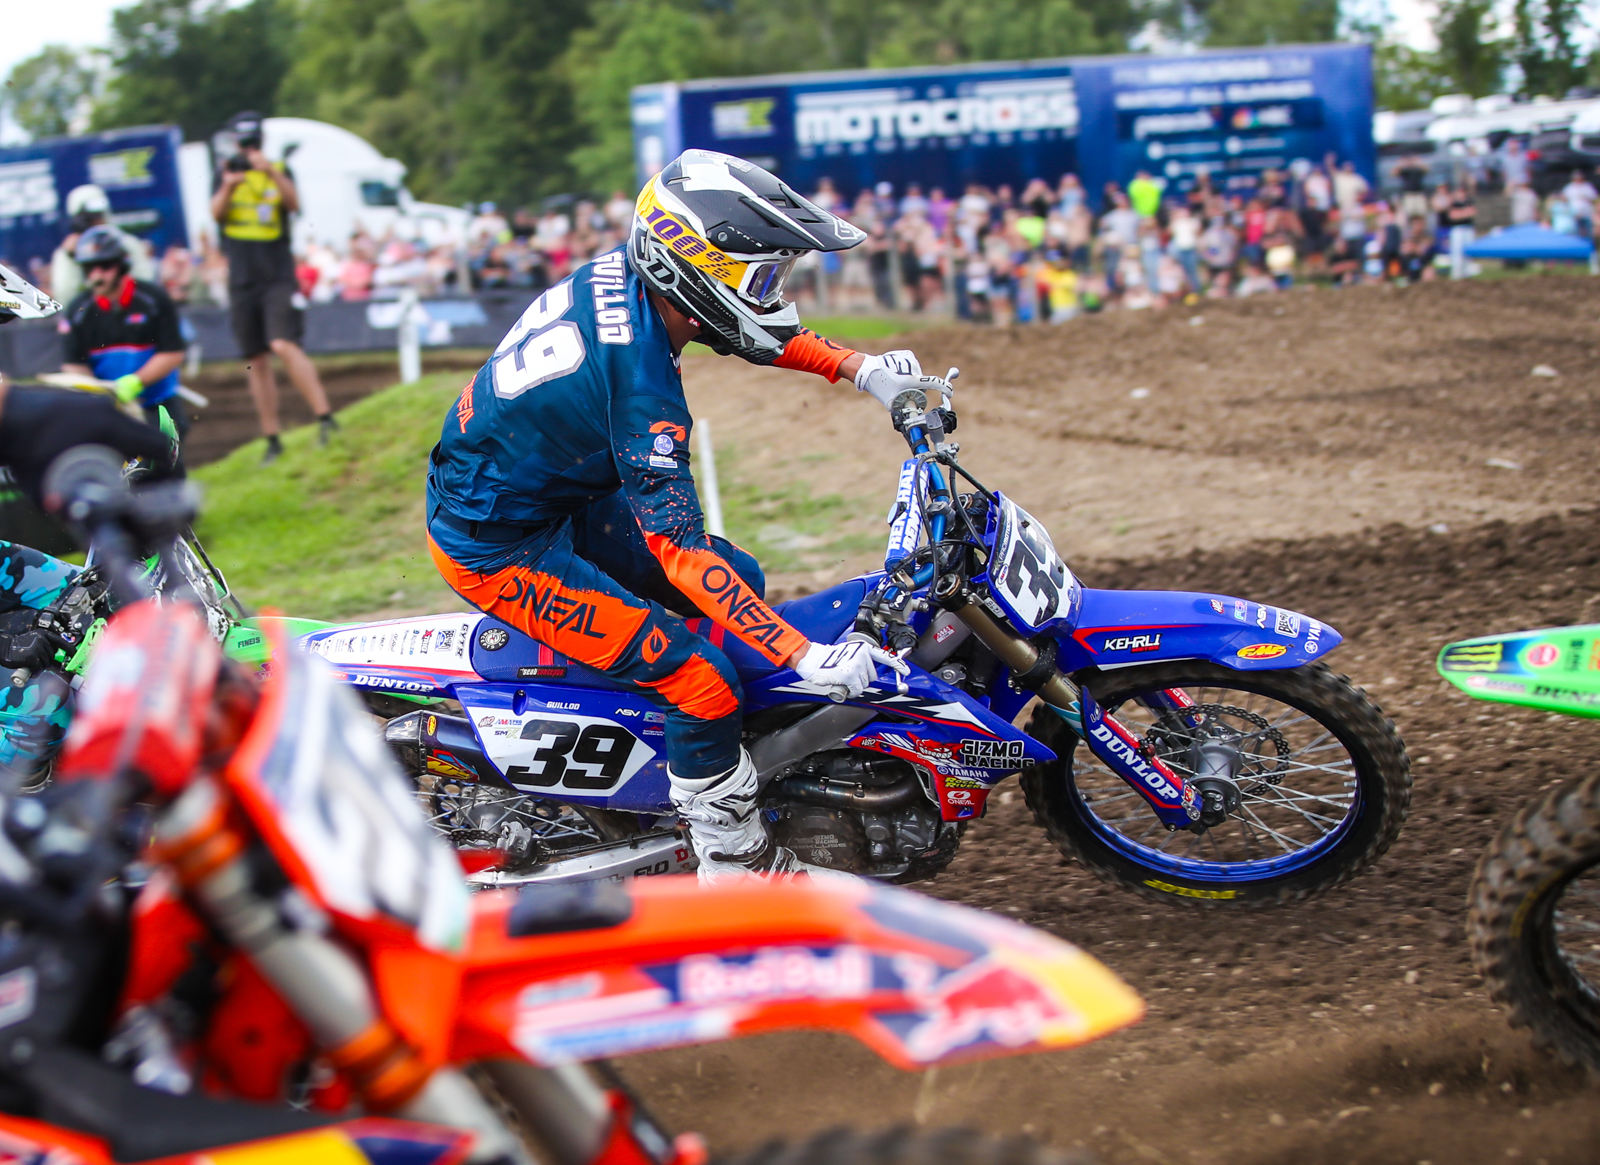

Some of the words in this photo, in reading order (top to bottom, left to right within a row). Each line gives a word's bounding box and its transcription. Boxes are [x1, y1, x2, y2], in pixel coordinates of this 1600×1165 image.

[795, 93, 1079, 145] MOTOCROSS
[889, 463, 917, 550] RENHAL
[1238, 645, 1287, 658] FMF
[353, 674, 434, 693] DUNLOP
[547, 701, 580, 710] GUILLOD
[615, 708, 641, 717] ASV
[505, 719, 638, 789] 39
[960, 739, 1024, 758] GIZMO
[964, 755, 1036, 769] RACING
[1090, 724, 1180, 800] DUNLOP
[947, 767, 990, 778] YAMAHA
